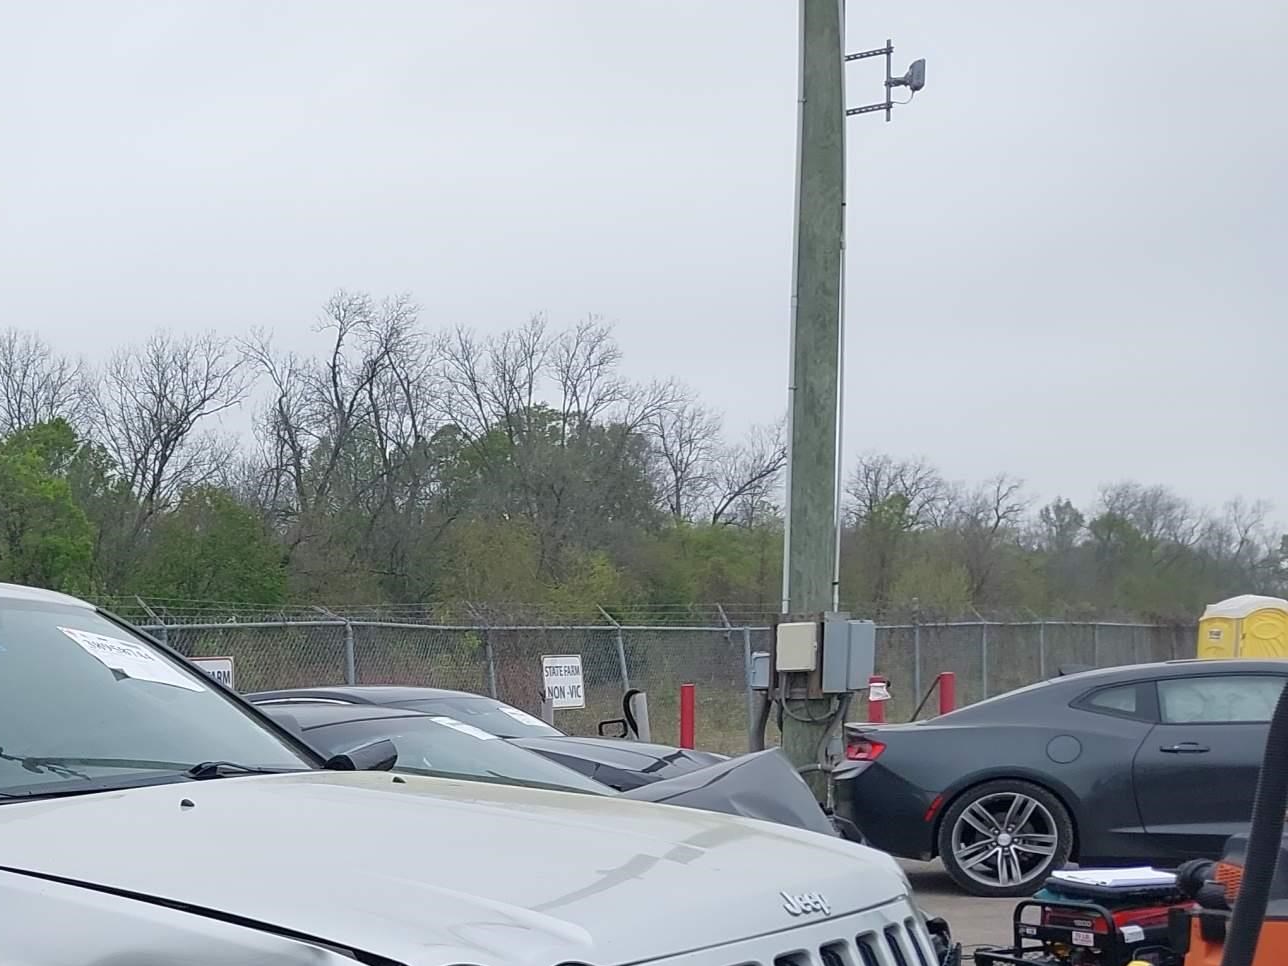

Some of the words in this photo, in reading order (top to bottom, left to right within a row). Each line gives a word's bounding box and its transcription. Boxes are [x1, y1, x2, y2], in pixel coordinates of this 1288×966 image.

[209, 670, 231, 685] ARM
[545, 665, 564, 677] STATE
[564, 665, 581, 677] FARM
[779, 890, 831, 916] Jeep
